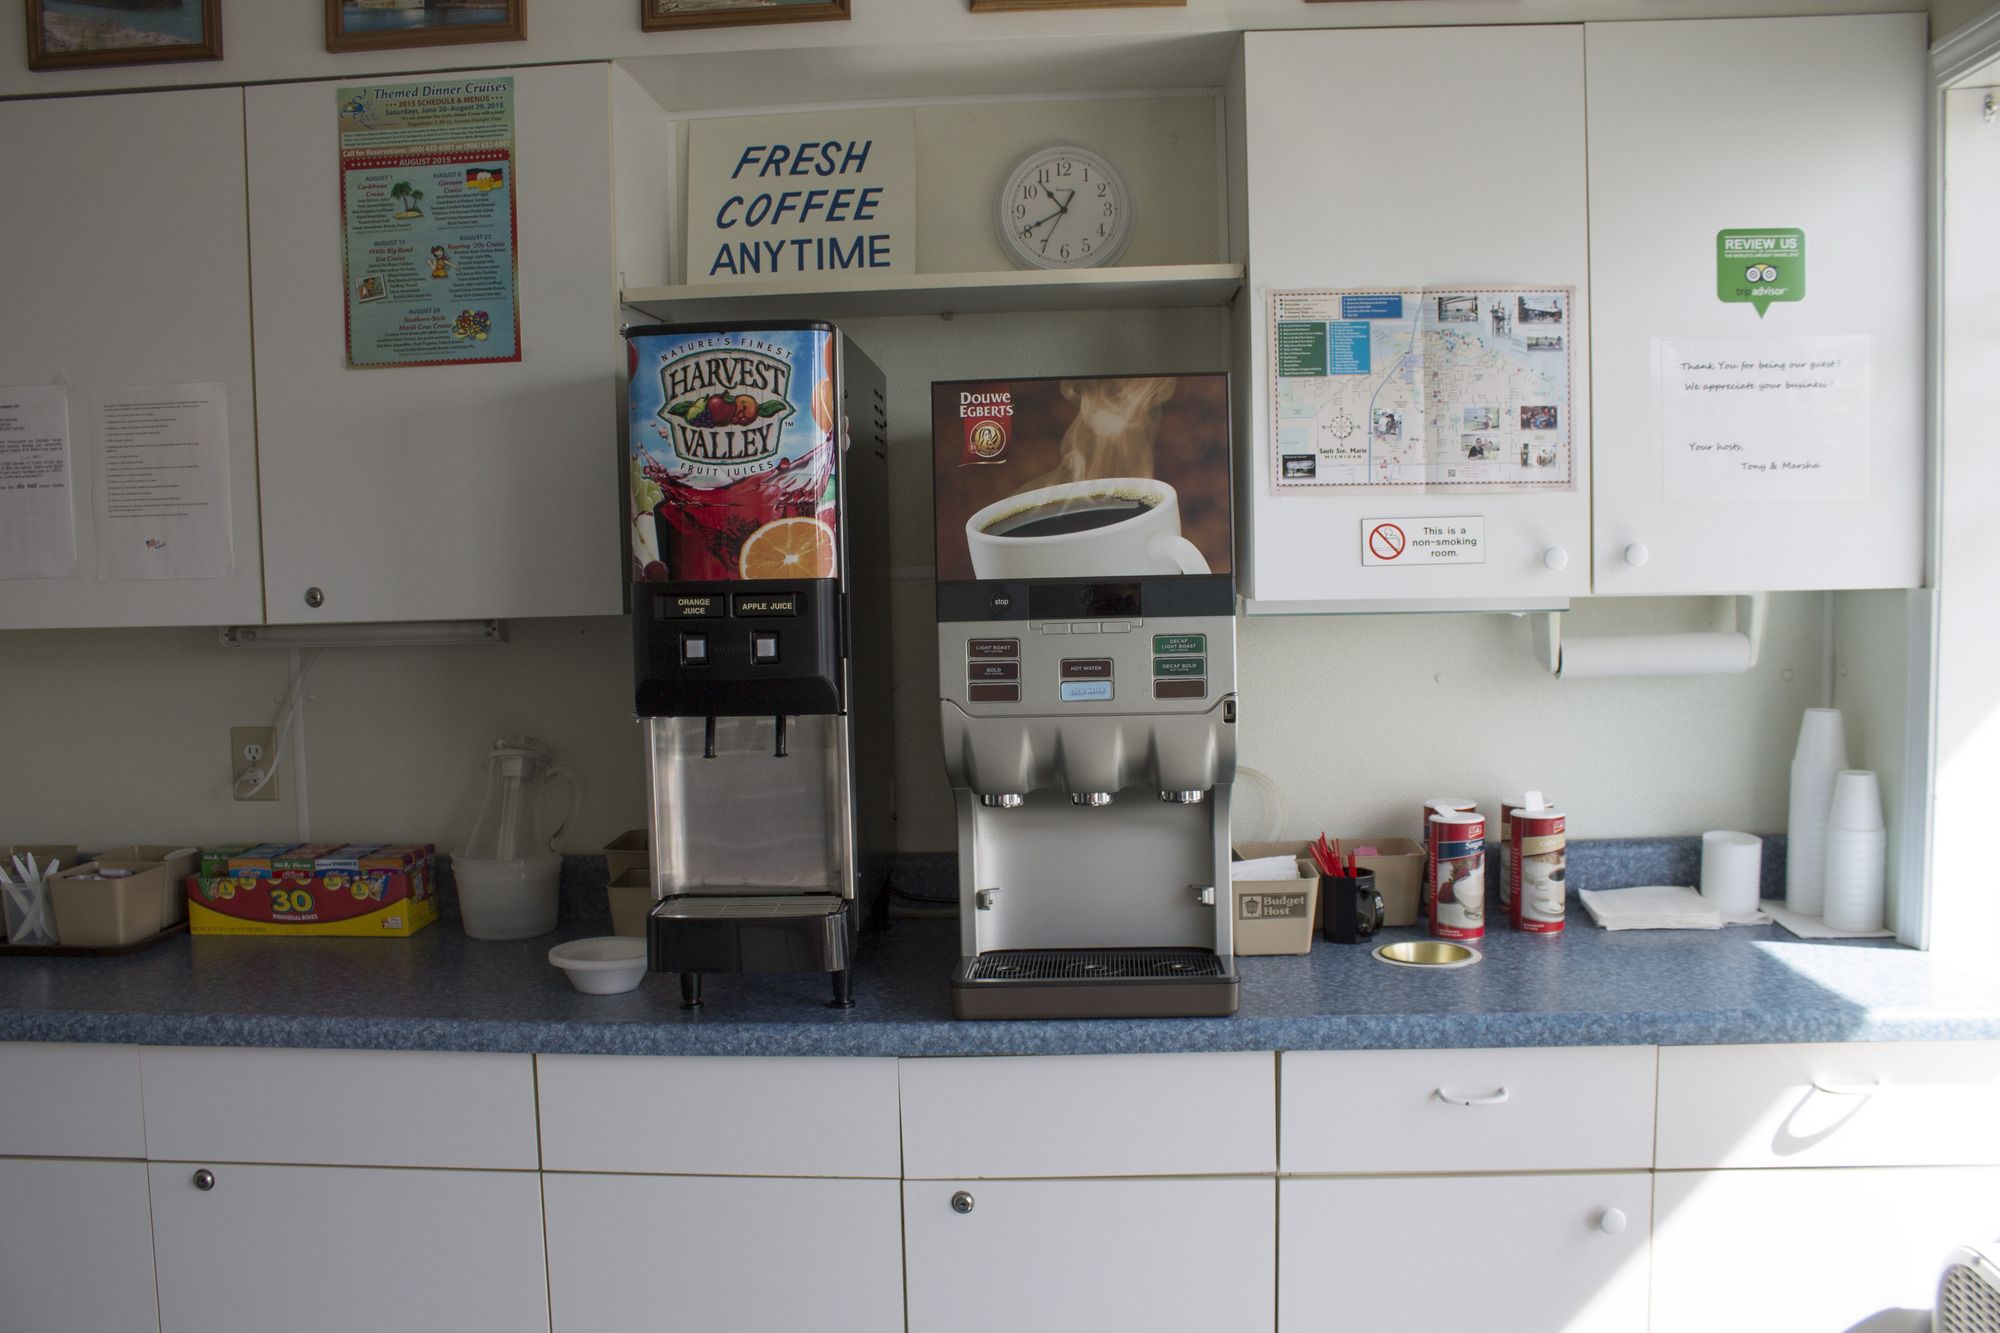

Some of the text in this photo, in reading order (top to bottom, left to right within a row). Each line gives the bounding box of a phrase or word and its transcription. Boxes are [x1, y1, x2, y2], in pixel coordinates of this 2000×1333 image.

[374, 82, 507, 100] Themed Dinner Cruises
[398, 100, 416, 108] 2015
[418, 98, 455, 106] SCHEDULE
[422, 106, 436, 114] June
[451, 104, 476, 113] August
[343, 150, 355, 158] Call
[366, 147, 407, 156] Reservations:
[400, 158, 432, 166] AUGUST
[731, 140, 873, 179] FRESH
[1056, 162, 1072, 176] 12
[1084, 168, 1089, 182] 1
[1038, 169, 1050, 182] 11
[366, 190, 384, 198] Cruise
[1023, 185, 1038, 200] 10
[1097, 182, 1106, 198] 2
[716, 187, 884, 229] COFFEE
[1016, 204, 1026, 219] 9
[1104, 202, 1112, 217] 3
[1023, 224, 1033, 240] 8
[1096, 222, 1106, 237] 4
[1040, 239, 1048, 254] 7
[1081, 238, 1091, 253] 5
[1724, 238, 1798, 250] REVIEW US
[708, 234, 891, 276] ANYTIME
[1060, 244, 1070, 259] 6
[1736, 286, 1786, 298] tripadvisor
[400, 324, 417, 332] Mardi
[434, 322, 452, 330] Cruise
[660, 337, 792, 362] NATURE'S FINEST
[1681, 360, 1715, 371] Thank
[1718, 360, 1738, 370] You
[1740, 360, 1754, 372] for
[1758, 360, 1786, 372] being
[668, 357, 787, 400] HARVEST
[1685, 382, 1700, 391] We
[1702, 381, 1756, 393] appreciate
[1759, 383, 1781, 392] your
[960, 405, 1014, 418] EGBERTS
[677, 422, 775, 459] VALLEY
[1689, 442, 1713, 452] Your
[680, 460, 774, 478] FRUIT JUICES
[1741, 461, 1821, 472] Tony & Marsha
[1423, 527, 1444, 536] This
[1447, 526, 1456, 535] is
[1412, 537, 1477, 547] non-smoking
[1431, 549, 1459, 557] room.
[678, 598, 710, 606] ORANGE
[742, 602, 792, 610] APPLE JUICE
[994, 598, 1008, 606] stop
[683, 607, 706, 615] JUICE
[1465, 841, 1484, 850] Sugar
[270, 890, 313, 912] 30
[1263, 896, 1305, 907] Budget
[1263, 906, 1290, 916] Host
